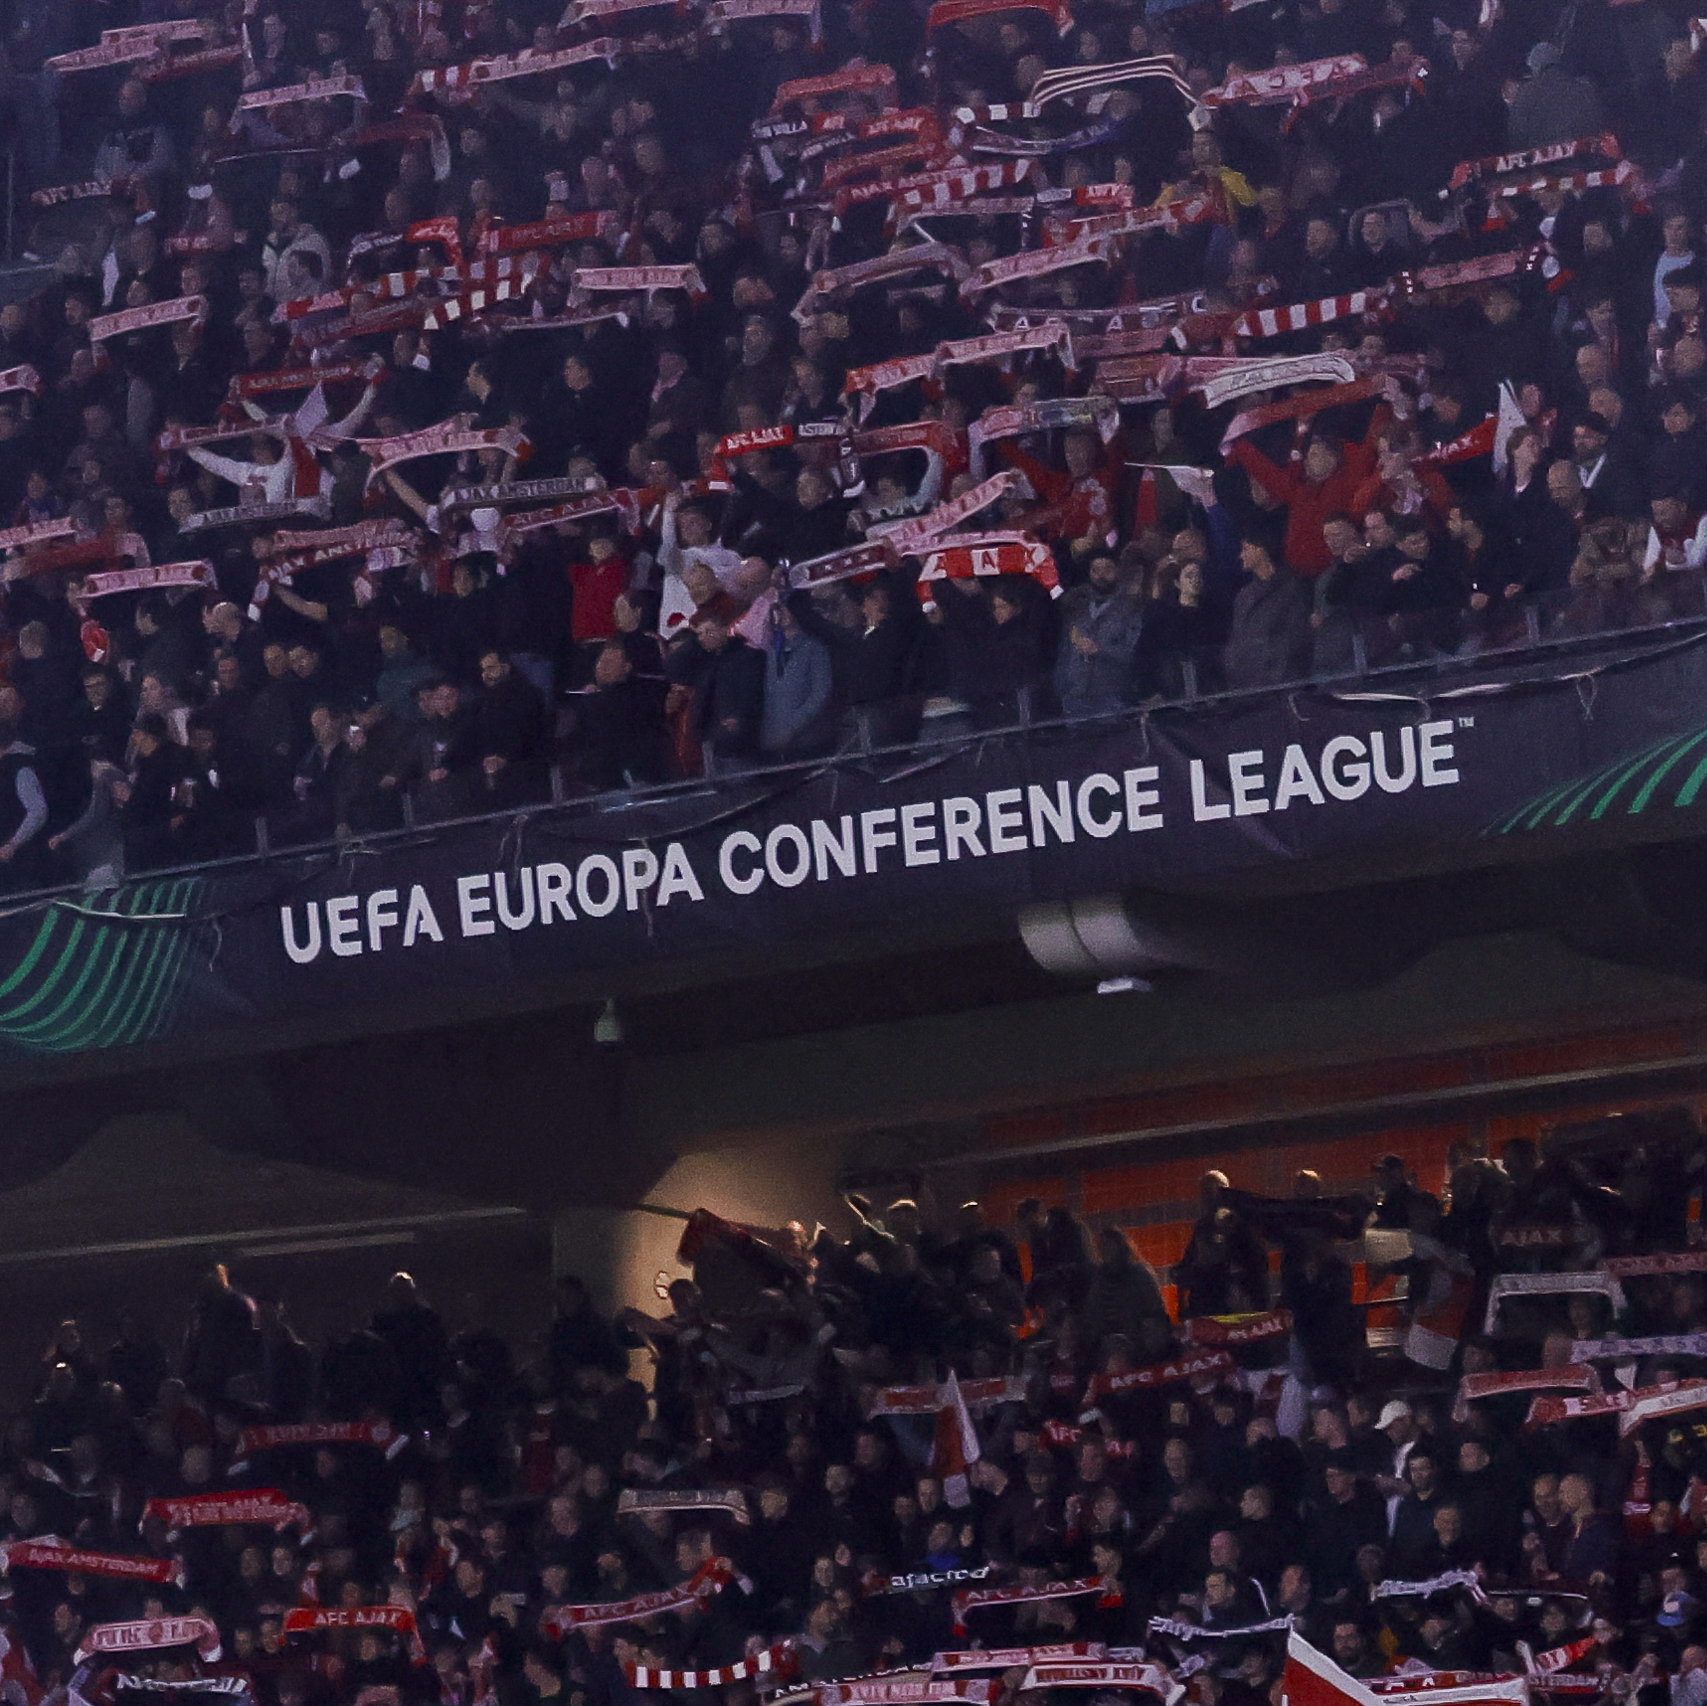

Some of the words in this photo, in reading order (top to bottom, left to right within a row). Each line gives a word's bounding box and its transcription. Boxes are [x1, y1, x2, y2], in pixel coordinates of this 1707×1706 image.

[1496, 152, 1525, 172] AFC
[1532, 143, 1577, 164] AJAX
[281, 884, 444, 963] UEFA
[457, 842, 705, 937] EUROPA
[719, 766, 1164, 895] CONFERENCE
[1189, 719, 1460, 822] LEAGUE
[1110, 1372, 1152, 1389] AFC
[1164, 1354, 1222, 1378] AJAX
[70, 1553, 160, 1577] AMSTERDAM
[315, 1614, 348, 1627] AFC
